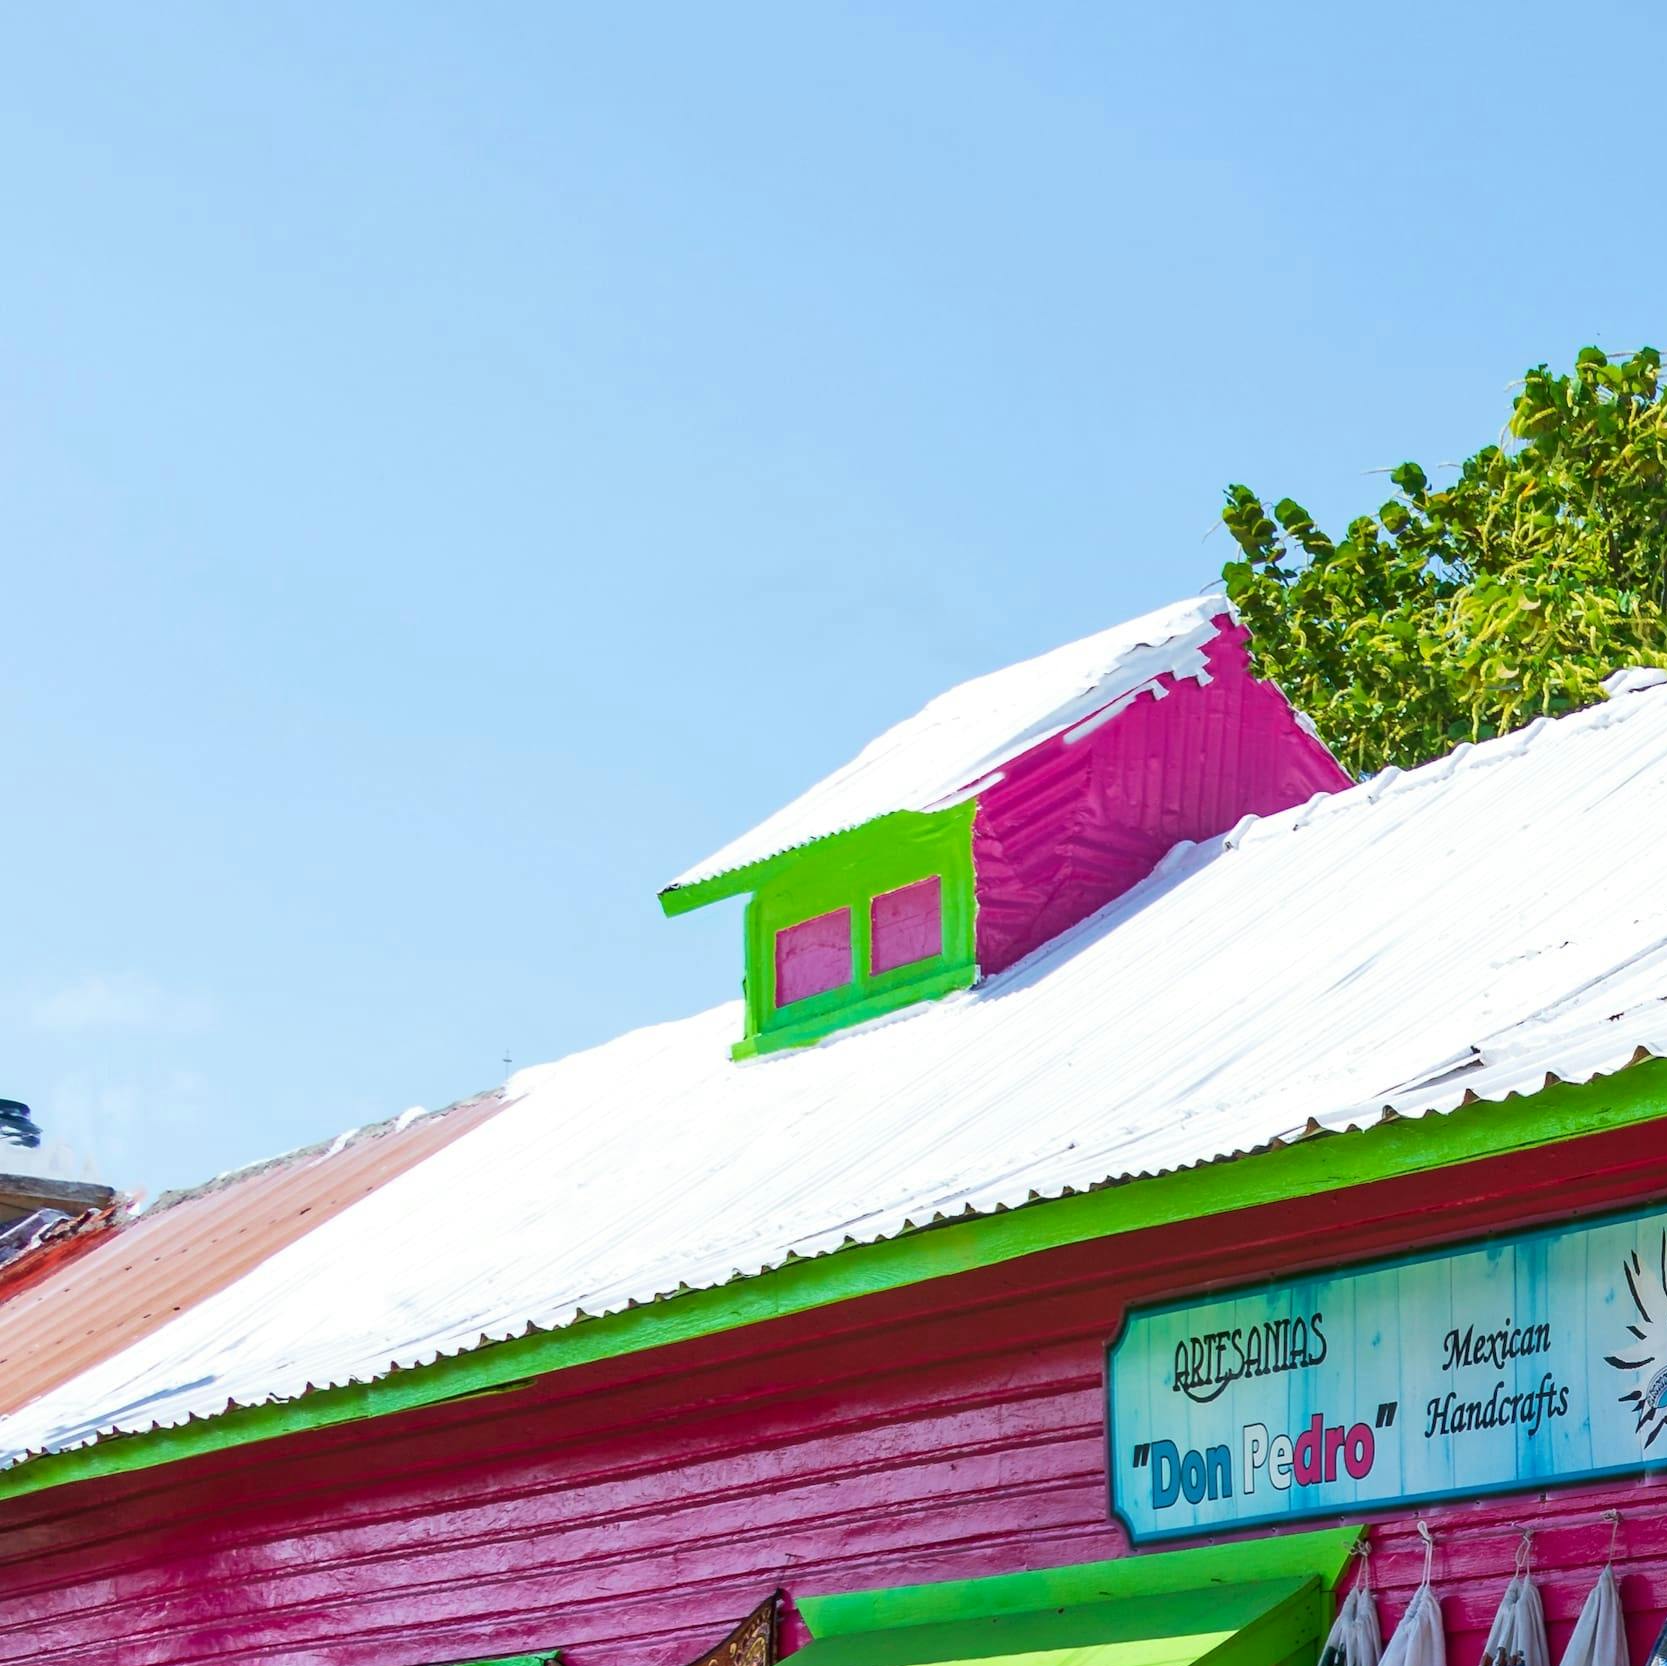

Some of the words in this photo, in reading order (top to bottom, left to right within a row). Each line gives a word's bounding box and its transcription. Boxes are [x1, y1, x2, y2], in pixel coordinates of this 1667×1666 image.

[1172, 1312, 1327, 1403] ARTESANIAS
[1442, 1318, 1551, 1371] Mexican
[1424, 1372, 1570, 1437] Handcrafts
